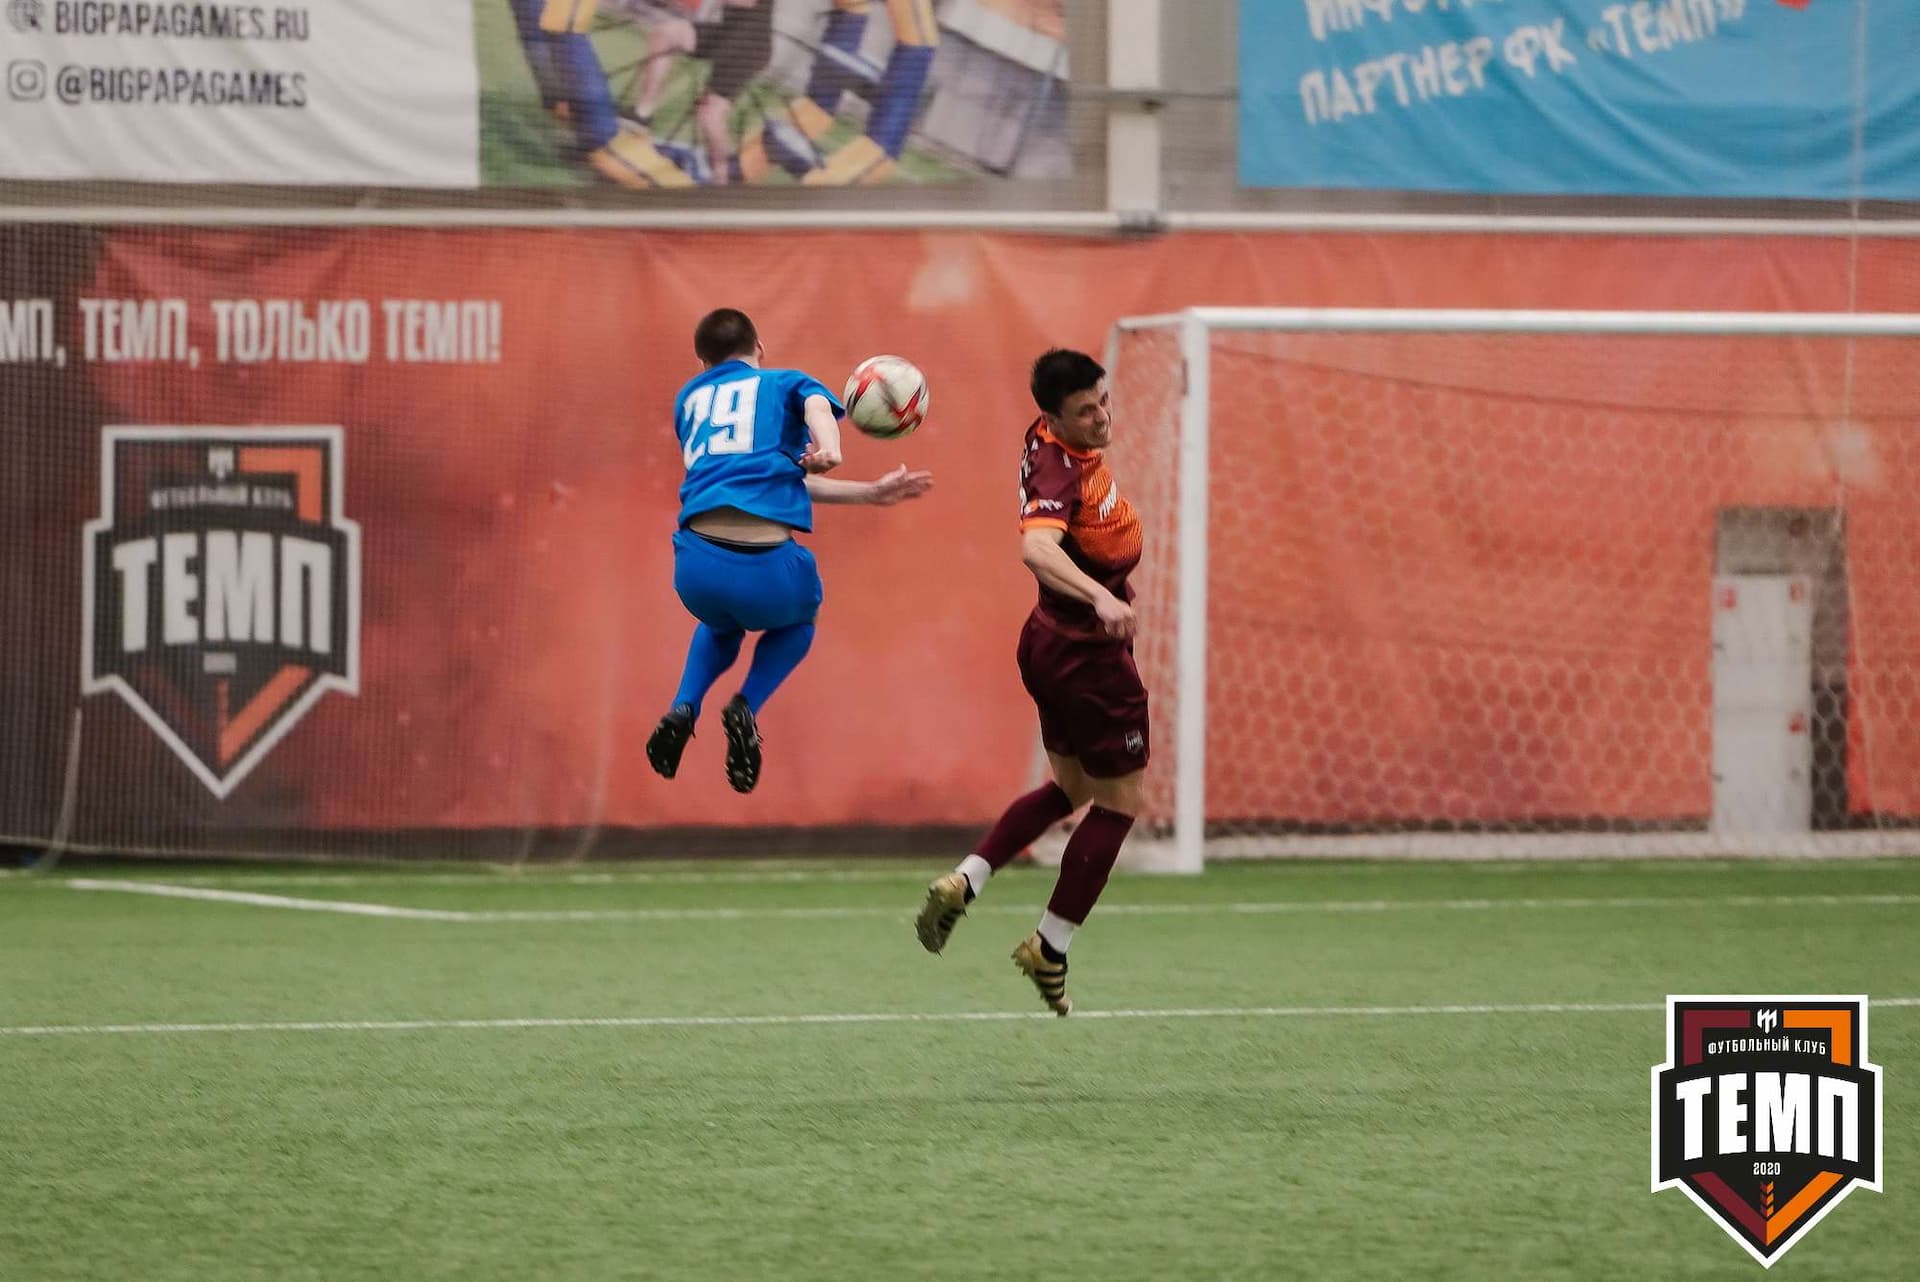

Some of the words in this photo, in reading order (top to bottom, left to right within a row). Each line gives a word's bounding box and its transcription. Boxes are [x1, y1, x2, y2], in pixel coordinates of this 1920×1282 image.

[56, 65, 308, 108] @BIGPAPAGAMES
[1300, 36, 1494, 126] ПАРТНЕР
[1503, 17, 1577, 79] ФК
[80, 299, 199, 369] ТЕМП,
[212, 299, 371, 363] ТОЛЬКО
[382, 299, 502, 363] ТЕМП!
[682, 375, 761, 471] 29
[112, 530, 332, 655] ТЕМП
